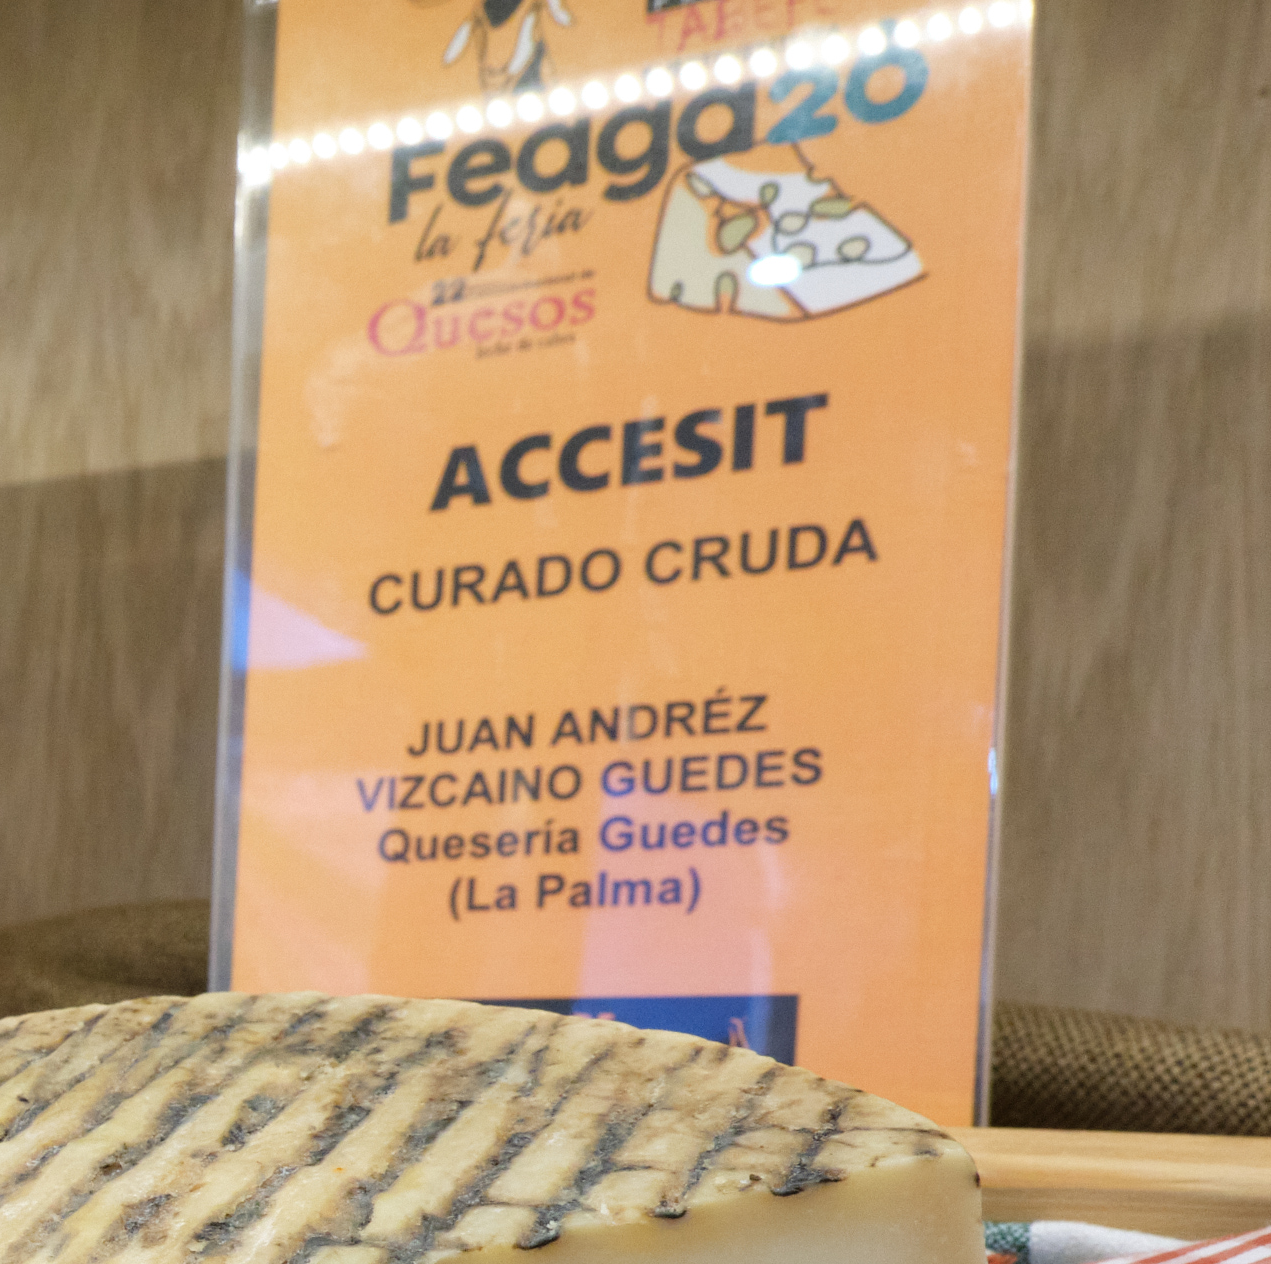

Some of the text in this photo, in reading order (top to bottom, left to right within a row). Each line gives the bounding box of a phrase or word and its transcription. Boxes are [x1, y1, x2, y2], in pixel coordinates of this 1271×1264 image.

[366, 288, 598, 358] Quesos
[428, 393, 830, 513] ACCESIT
[368, 517, 879, 616] CURADO CRUDA
[408, 687, 768, 757] JUAN ANDRÉZ
[356, 746, 824, 814] VIZCAINO GUEDES
[377, 813, 790, 864] Quesería Guedes
[448, 868, 702, 920] (La Palma)
